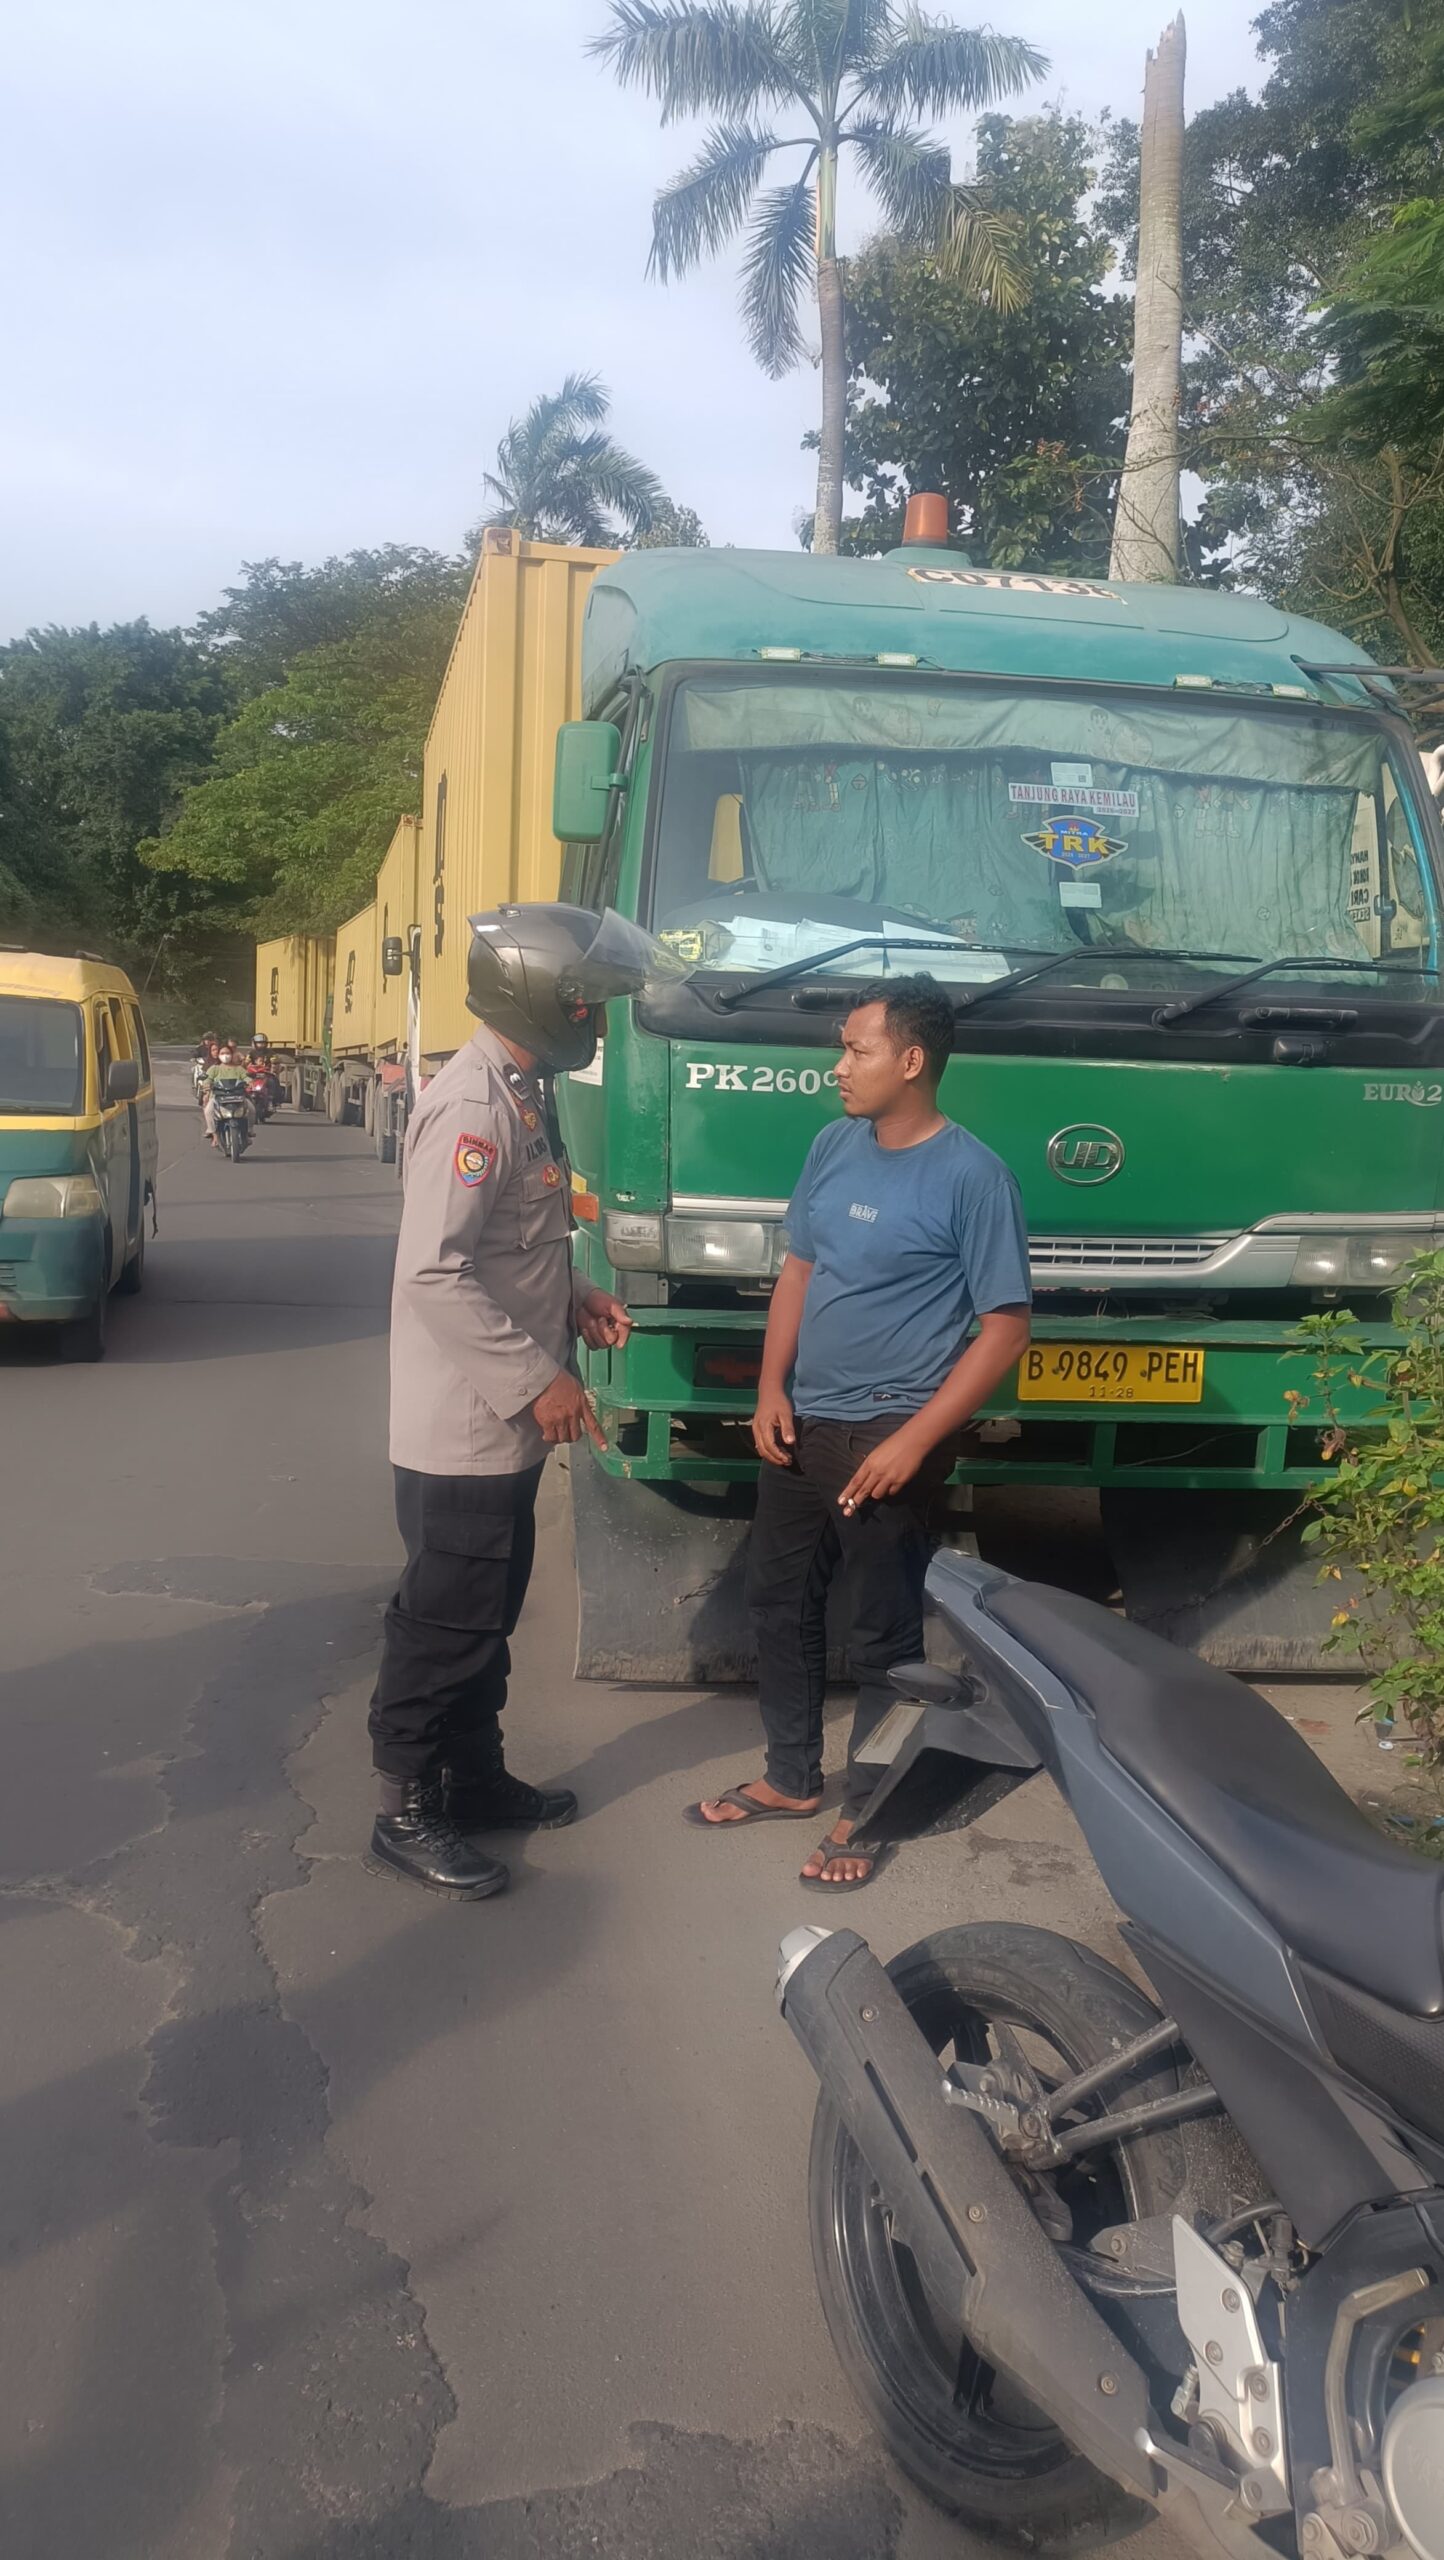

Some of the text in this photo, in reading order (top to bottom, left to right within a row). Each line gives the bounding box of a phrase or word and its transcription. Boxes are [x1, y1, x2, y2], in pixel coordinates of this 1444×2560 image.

[1010, 785, 1136, 807] TANJUNG RAYA KEMILAU
[1039, 833, 1109, 854] TRK
[1427, 1085, 1442, 1101] 2
[1028, 1351, 1198, 1383] B 9849 PEH
